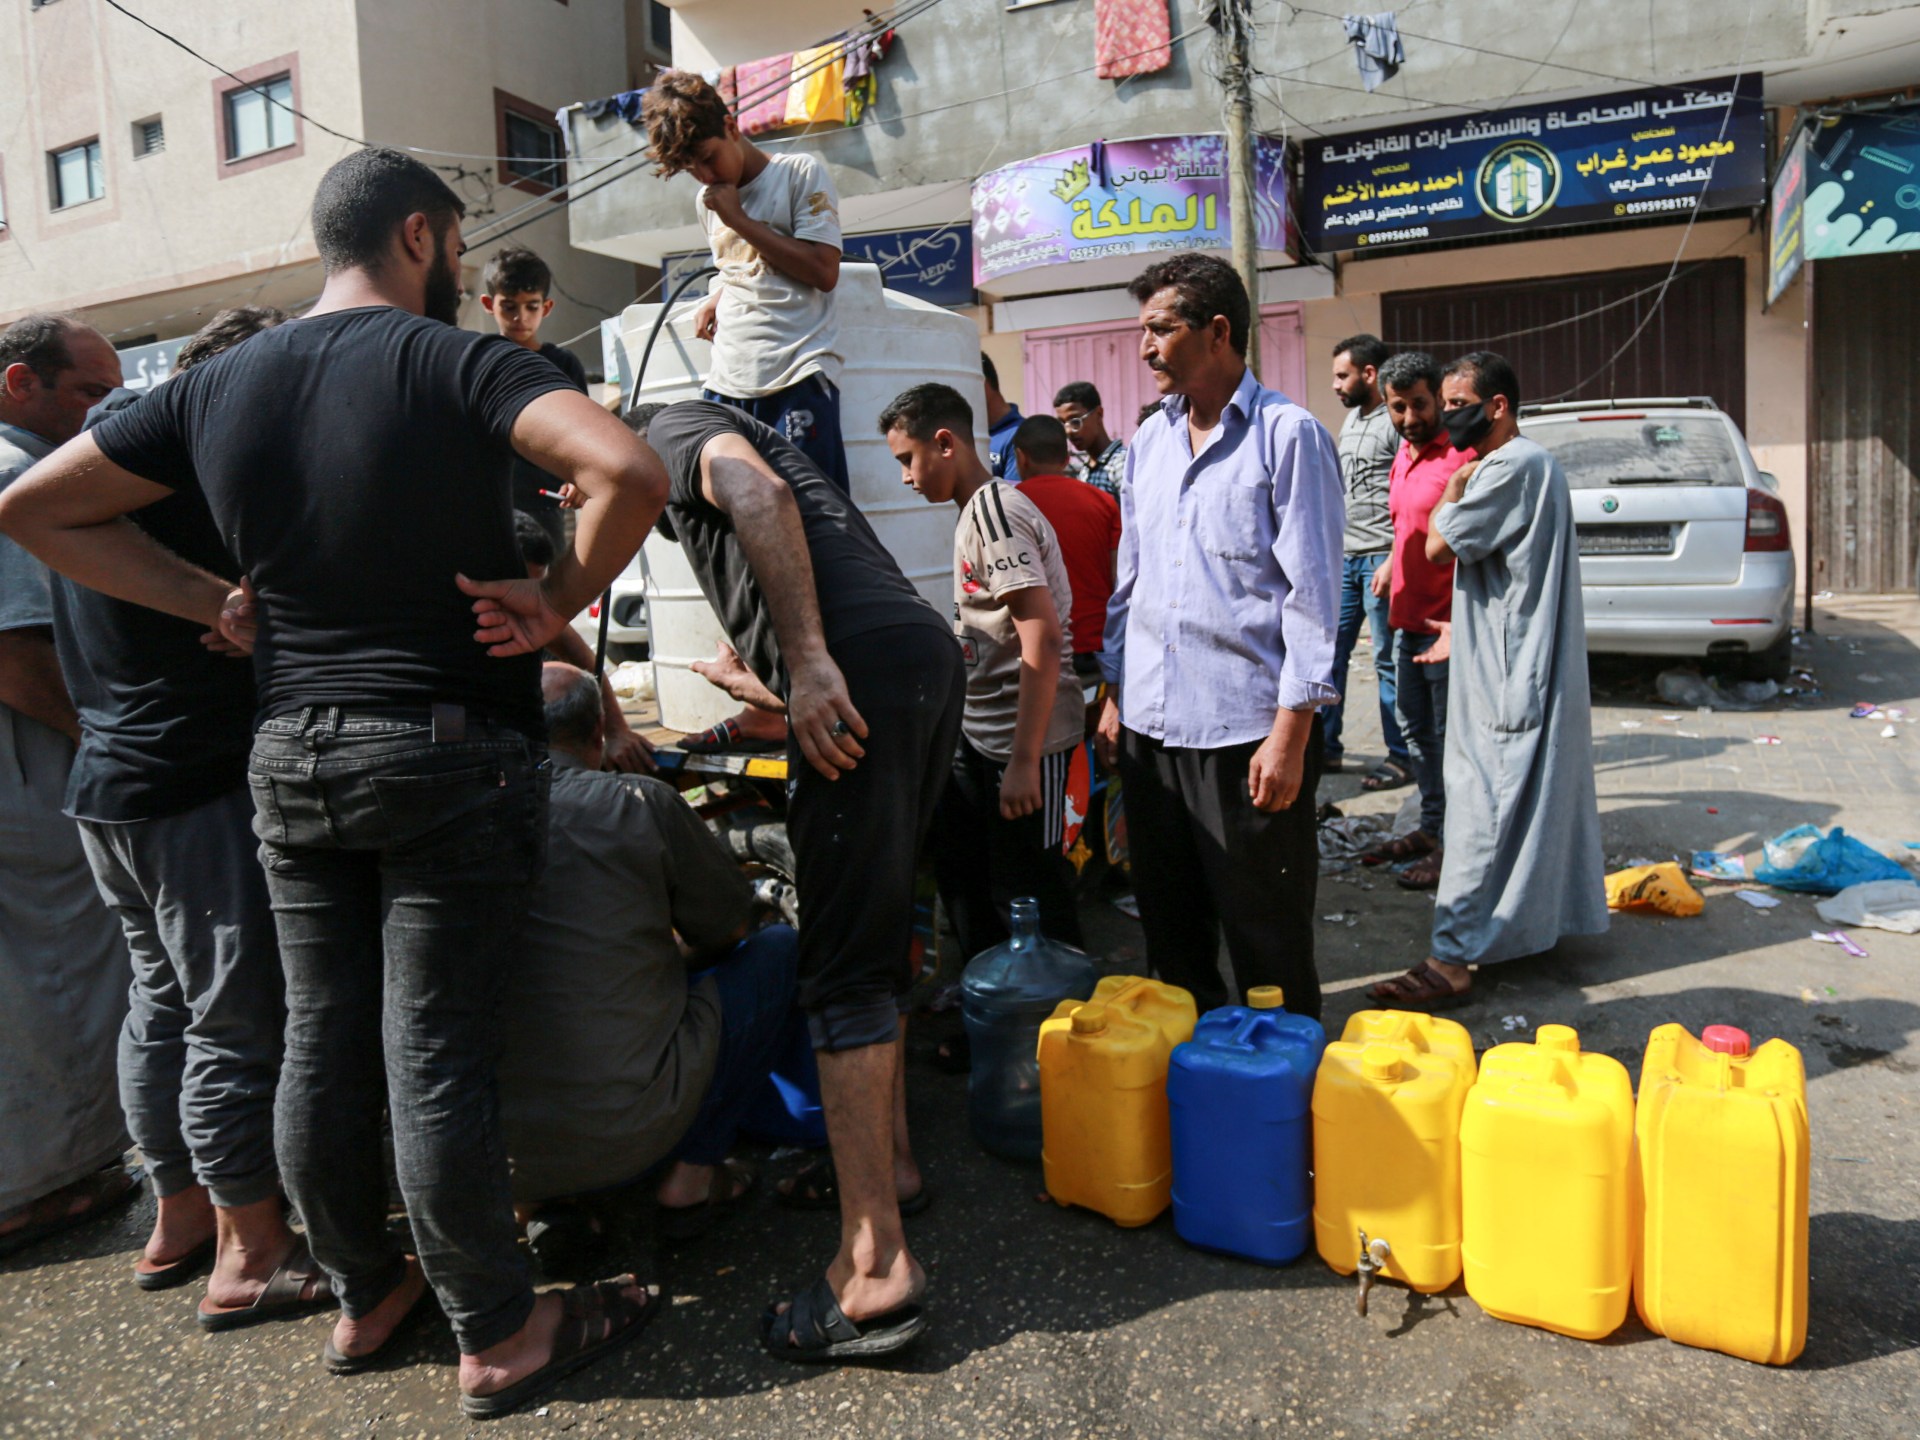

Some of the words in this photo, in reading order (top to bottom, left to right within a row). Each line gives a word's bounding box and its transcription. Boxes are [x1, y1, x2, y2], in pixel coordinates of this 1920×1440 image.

[1546, 100, 1646, 131] المحاماة
[1652, 91, 1735, 119] مكتب
[1415, 117, 1541, 150] والاستشارات
[1322, 134, 1411, 163] القانونية
[1629, 147, 1674, 171] عمر
[1677, 140, 1735, 164] محمود
[1174, 161, 1222, 182] سنتر
[1576, 148, 1628, 177] غراب
[1110, 165, 1169, 192] بيوتي
[1422, 166, 1464, 192] أحمد
[1609, 172, 1656, 193] شرعي
[1665, 166, 1713, 187] نظامي
[1377, 180, 1420, 198] محمد
[1071, 192, 1217, 240] الملكة
[1345, 209, 1375, 226] قانون
[1376, 203, 1419, 222] ماجستير
[1426, 197, 1464, 215] نظامي
[1324, 214, 1345, 230] عام
[918, 259, 957, 283] AEDC
